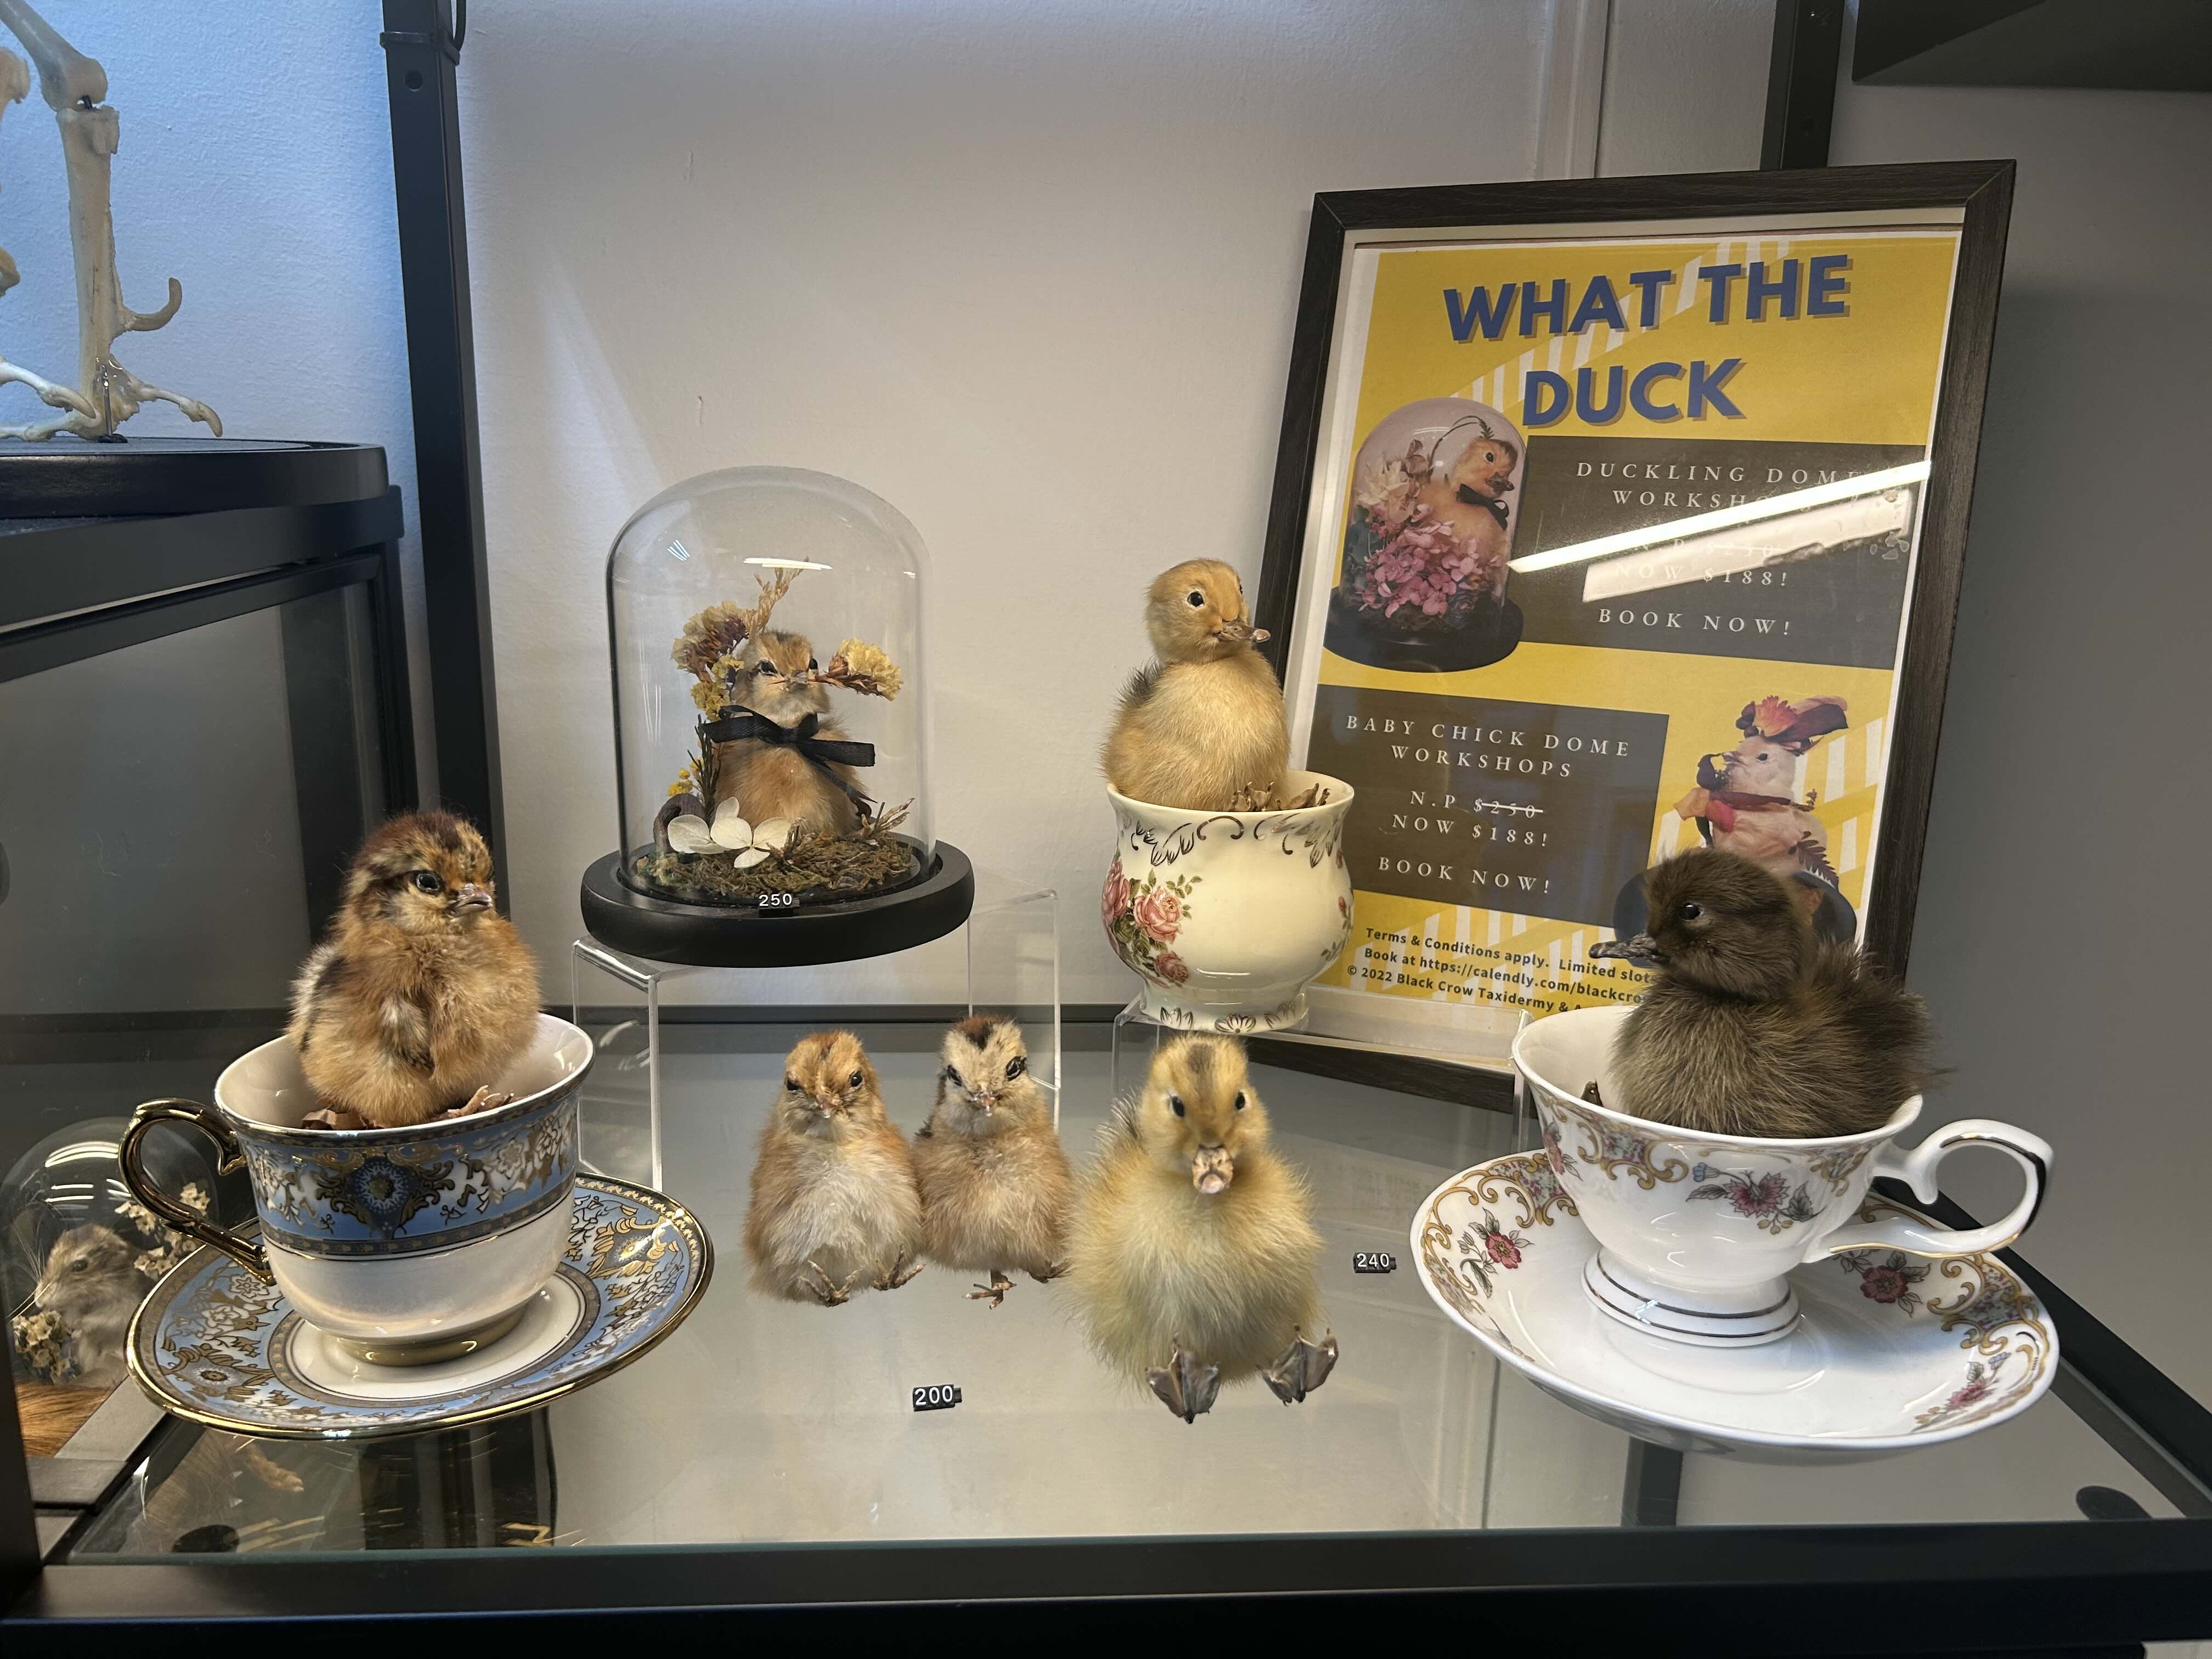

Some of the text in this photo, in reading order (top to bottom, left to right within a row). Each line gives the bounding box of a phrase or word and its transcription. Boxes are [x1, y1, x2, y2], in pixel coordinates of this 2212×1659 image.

[1443, 255, 1852, 342] WHAT THE
[1522, 358, 1746, 428] DUCK
[1577, 462, 1745, 482] DUCKLING
[1616, 563, 1787, 587] NOW $188!
[1599, 608, 1791, 635] BOOK NOW!
[1346, 715, 1629, 757] BABY CHICK DOME
[1391, 744, 1571, 777] WORKSHOPS
[1392, 814, 1548, 847] NOW $188!
[1379, 856, 1550, 894] BOOK NOW!
[759, 893, 792, 906] 250
[1366, 928, 1650, 984] Terms & Conditions apply. Limited slot
[1361, 967, 1392, 981] 2022
[1397, 973, 1433, 989] Black
[1438, 981, 1473, 996] Crow
[1478, 987, 1554, 1012] Taxidermy
[1559, 1001, 1568, 1012] &
[1364, 947, 1644, 1003] Book at https://calendly.com/blackcro
[1357, 1253, 1389, 1268] 240
[915, 1385, 953, 1406] 200
